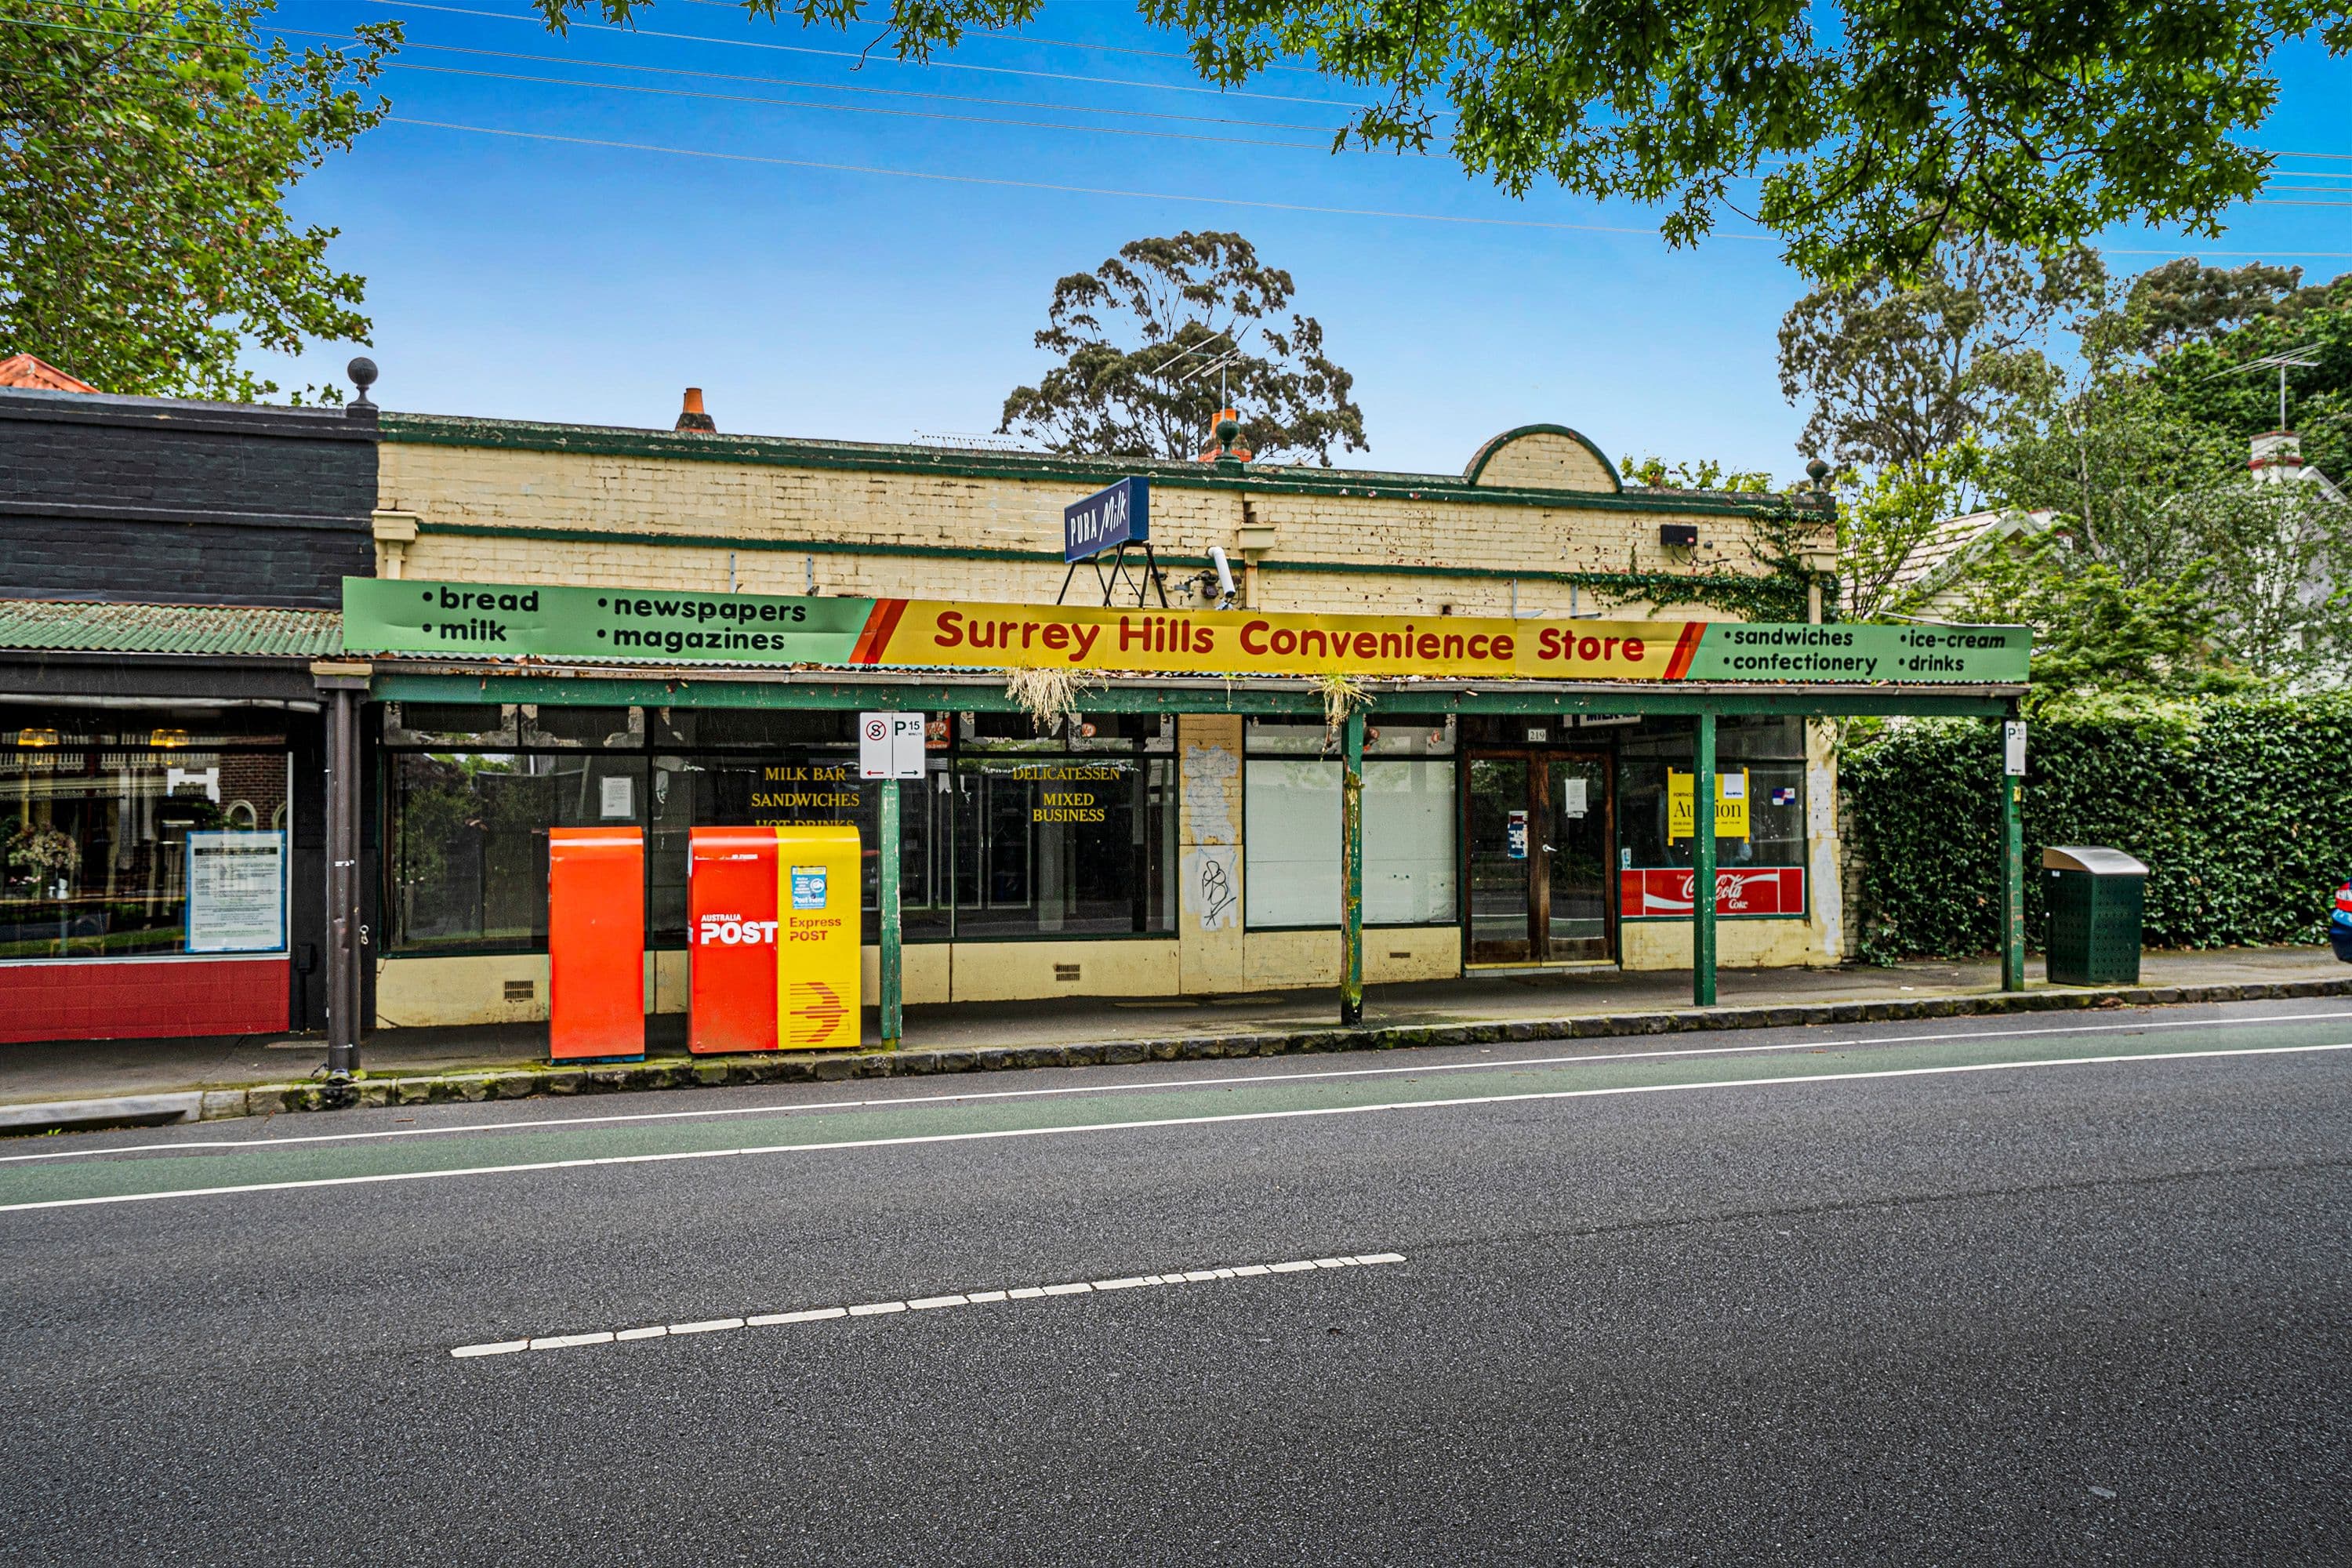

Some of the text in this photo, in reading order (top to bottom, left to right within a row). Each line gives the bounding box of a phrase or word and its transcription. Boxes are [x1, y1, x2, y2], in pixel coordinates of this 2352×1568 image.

[1070, 489, 1127, 547] PURA Milk
[441, 586, 539, 612] bread
[614, 598, 807, 625] newspapers
[441, 618, 507, 641] milk
[934, 611, 1645, 662] Surrey Hills Convenience Store
[1734, 627, 1853, 646] sandwiches
[1909, 629, 2005, 648] ice-cream
[614, 626, 785, 653] magazines
[1733, 652, 1878, 676] confectionery
[1908, 654, 1965, 671] drinks
[895, 720, 920, 736] P 15
[1530, 731, 1544, 740] 219
[2008, 728, 2016, 739] P
[765, 767, 846, 781] MILK BAR
[1012, 767, 1120, 780] DELICATESSEN
[751, 793, 860, 807] SANDWICHES
[1044, 793, 1094, 806] MIXED
[1674, 799, 1741, 818] Auion
[1033, 809, 1105, 822] BUSINESS
[789, 917, 841, 928] Express
[701, 921, 778, 945] POST
[790, 931, 828, 941] POST
